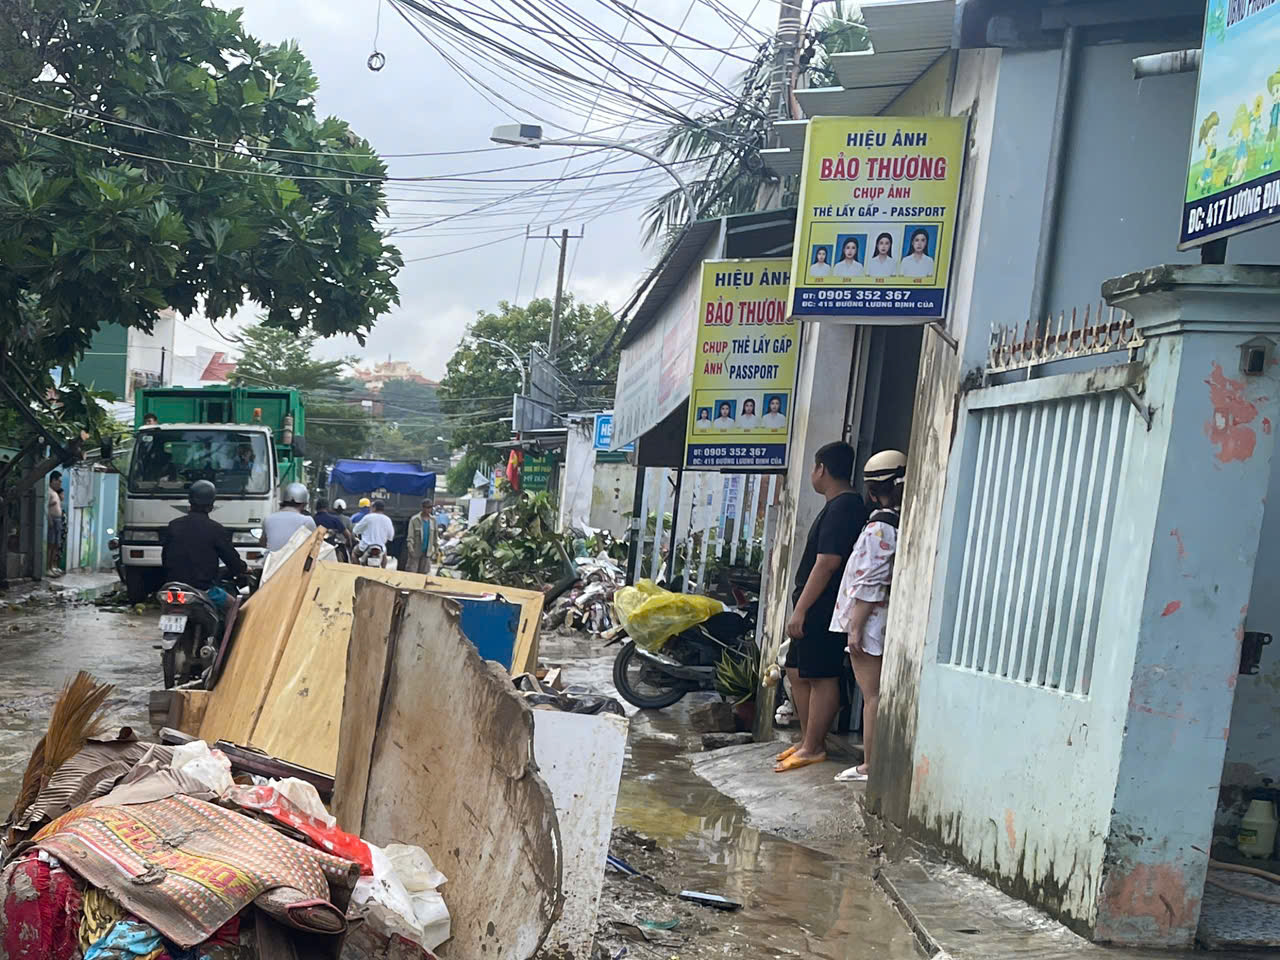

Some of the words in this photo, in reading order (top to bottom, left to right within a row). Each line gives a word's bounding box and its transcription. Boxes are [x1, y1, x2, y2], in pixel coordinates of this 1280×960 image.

[847, 130, 886, 149] HIỆU
[892, 129, 927, 147] ẢNH
[820, 152, 860, 180] BẢO
[866, 154, 946, 180] THƯƠNG
[853, 187, 884, 200] CHỤP
[888, 184, 911, 198] ẢNH
[813, 204, 832, 217] THẺ
[836, 203, 855, 217] LẤY
[858, 203, 879, 217] GẤP
[891, 207, 946, 217] PASSPORT
[1188, 206, 1205, 234] ĐC:
[1206, 198, 1226, 227] 417
[1226, 185, 1262, 222] LƯƠNG
[715, 269, 754, 289] HIỆU
[818, 290, 852, 300] 0905
[856, 290, 881, 300] 352
[885, 290, 911, 300] 367
[705, 296, 734, 325] BẢO
[738, 298, 794, 325] THƯƠN
[703, 341, 728, 356] CHỤP
[732, 335, 750, 353] THẺ
[753, 334, 770, 353] LẤY
[773, 334, 792, 353] GẤP
[704, 360, 722, 375] ẢNH
[729, 365, 779, 379] PASSPORT
[704, 448, 727, 456] 0905
[729, 448, 746, 456] 352
[749, 448, 767, 457] 367
